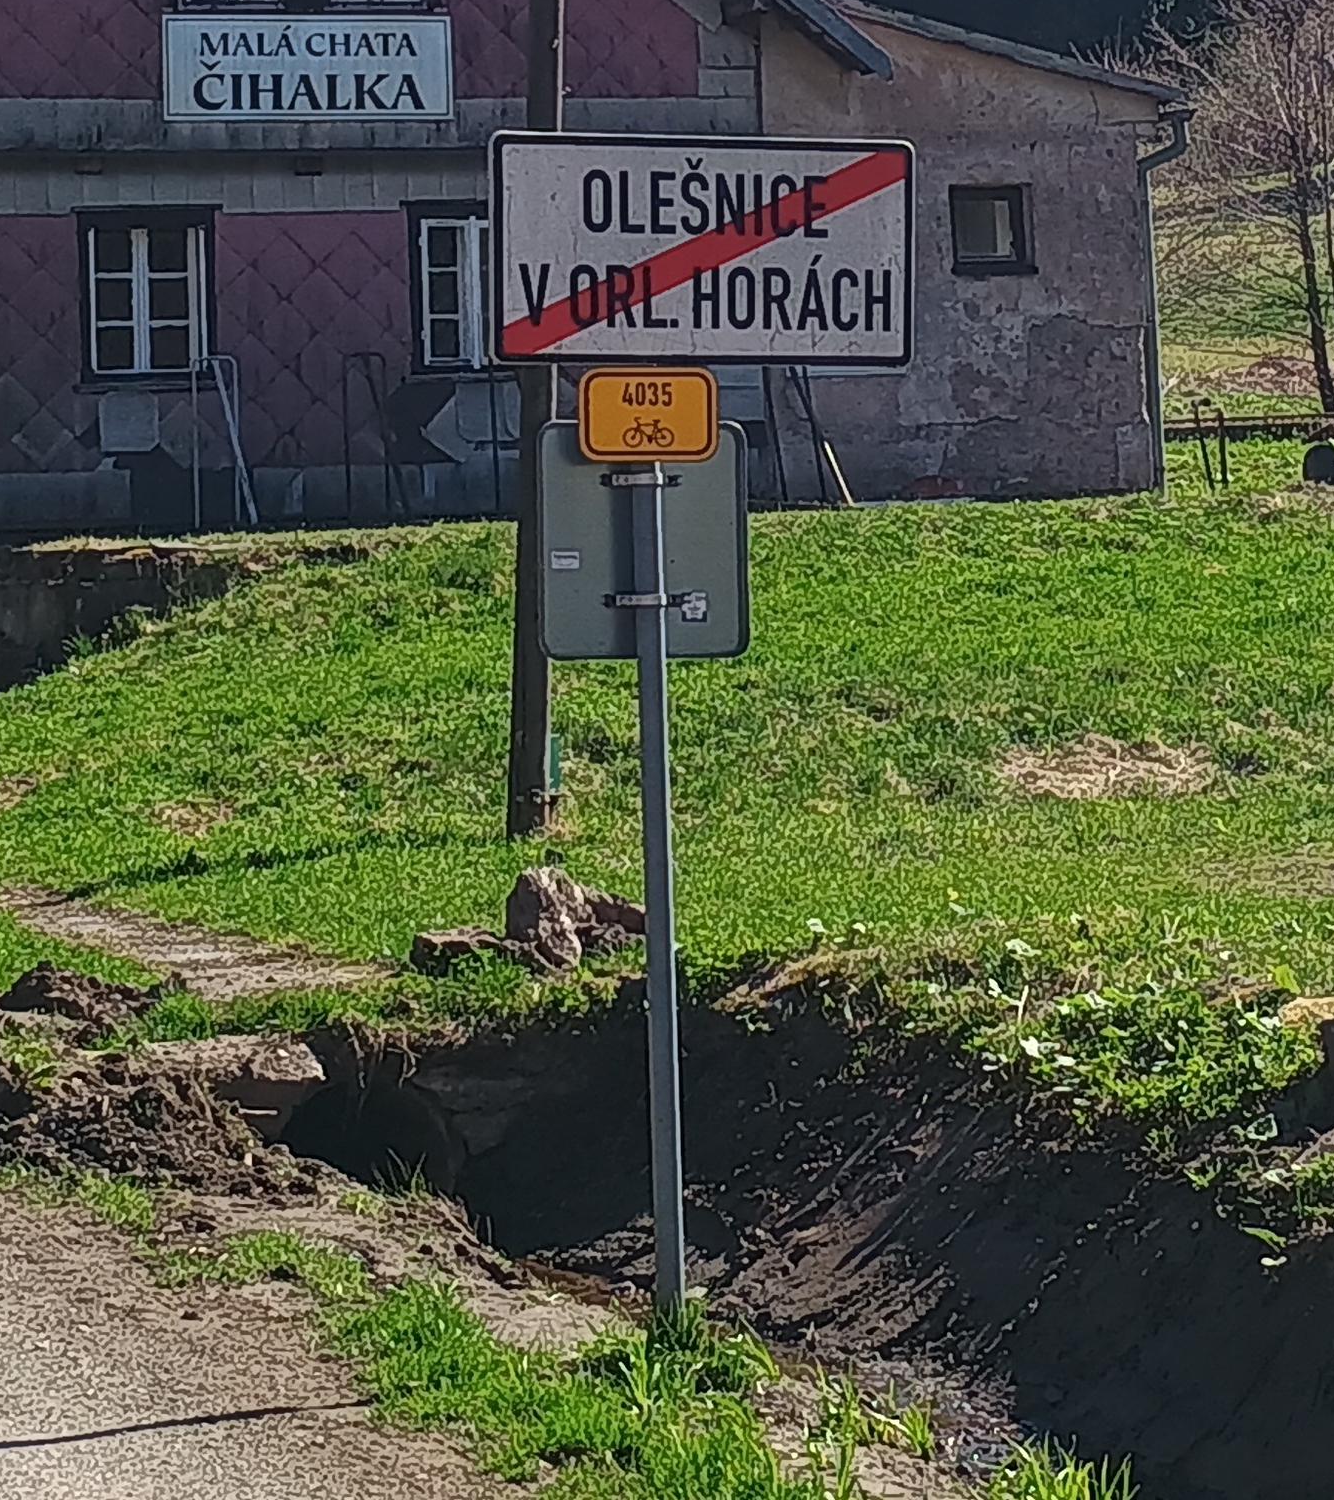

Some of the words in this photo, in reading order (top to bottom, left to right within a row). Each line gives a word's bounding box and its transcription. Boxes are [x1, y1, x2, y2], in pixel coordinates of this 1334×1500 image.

[199, 25, 297, 57] MALÁ
[305, 32, 418, 57] CHATA
[193, 59, 426, 110] ČIHALKA
[582, 157, 829, 239] OLEŠNICE
[518, 263, 551, 327] V
[570, 264, 679, 329] ORL.
[693, 254, 892, 332] HORÁCH
[622, 382, 673, 407] 4035
